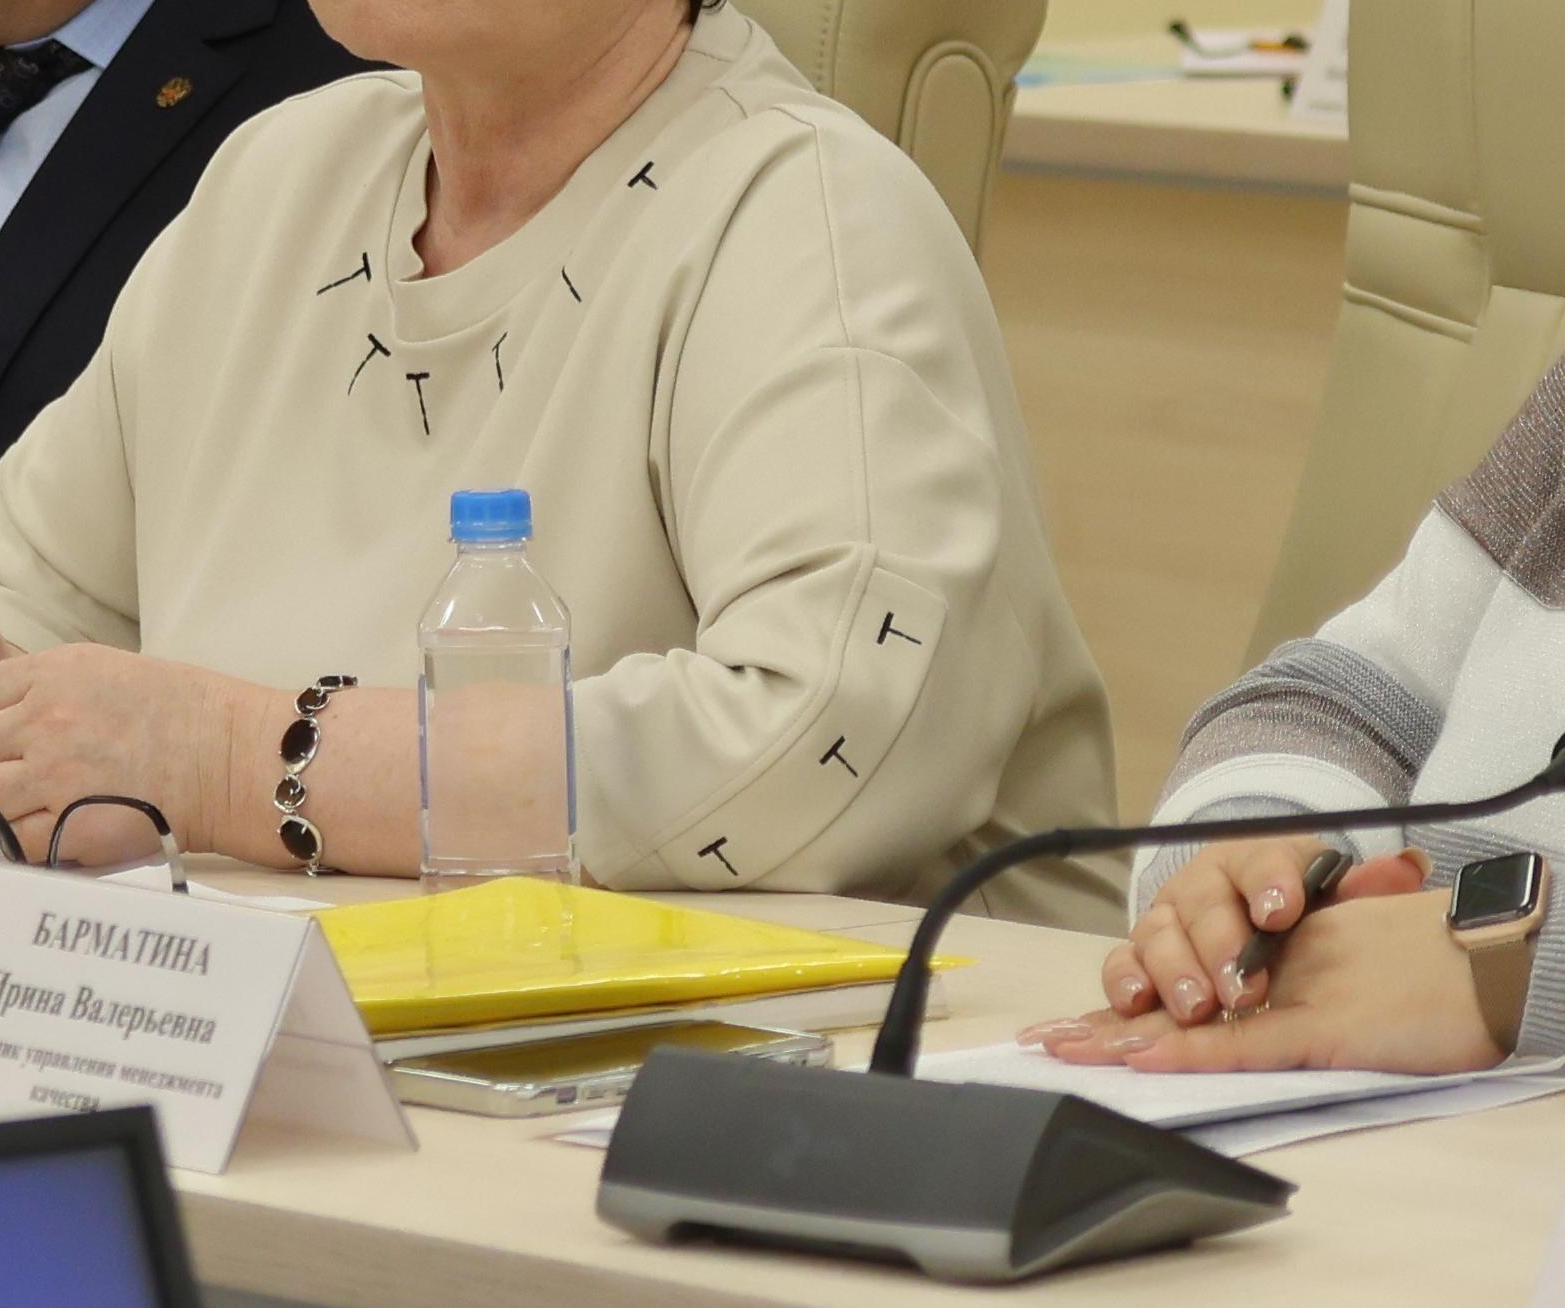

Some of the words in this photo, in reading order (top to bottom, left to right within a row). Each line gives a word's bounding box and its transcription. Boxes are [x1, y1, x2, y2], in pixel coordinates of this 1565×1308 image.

[32, 911, 213, 976] БАРМАТИНА
[69, 985, 218, 1045] Валерьевна
[22, 1046, 117, 1080] управления
[118, 1064, 224, 1100] менеджмента
[29, 1084, 101, 1113] качества
